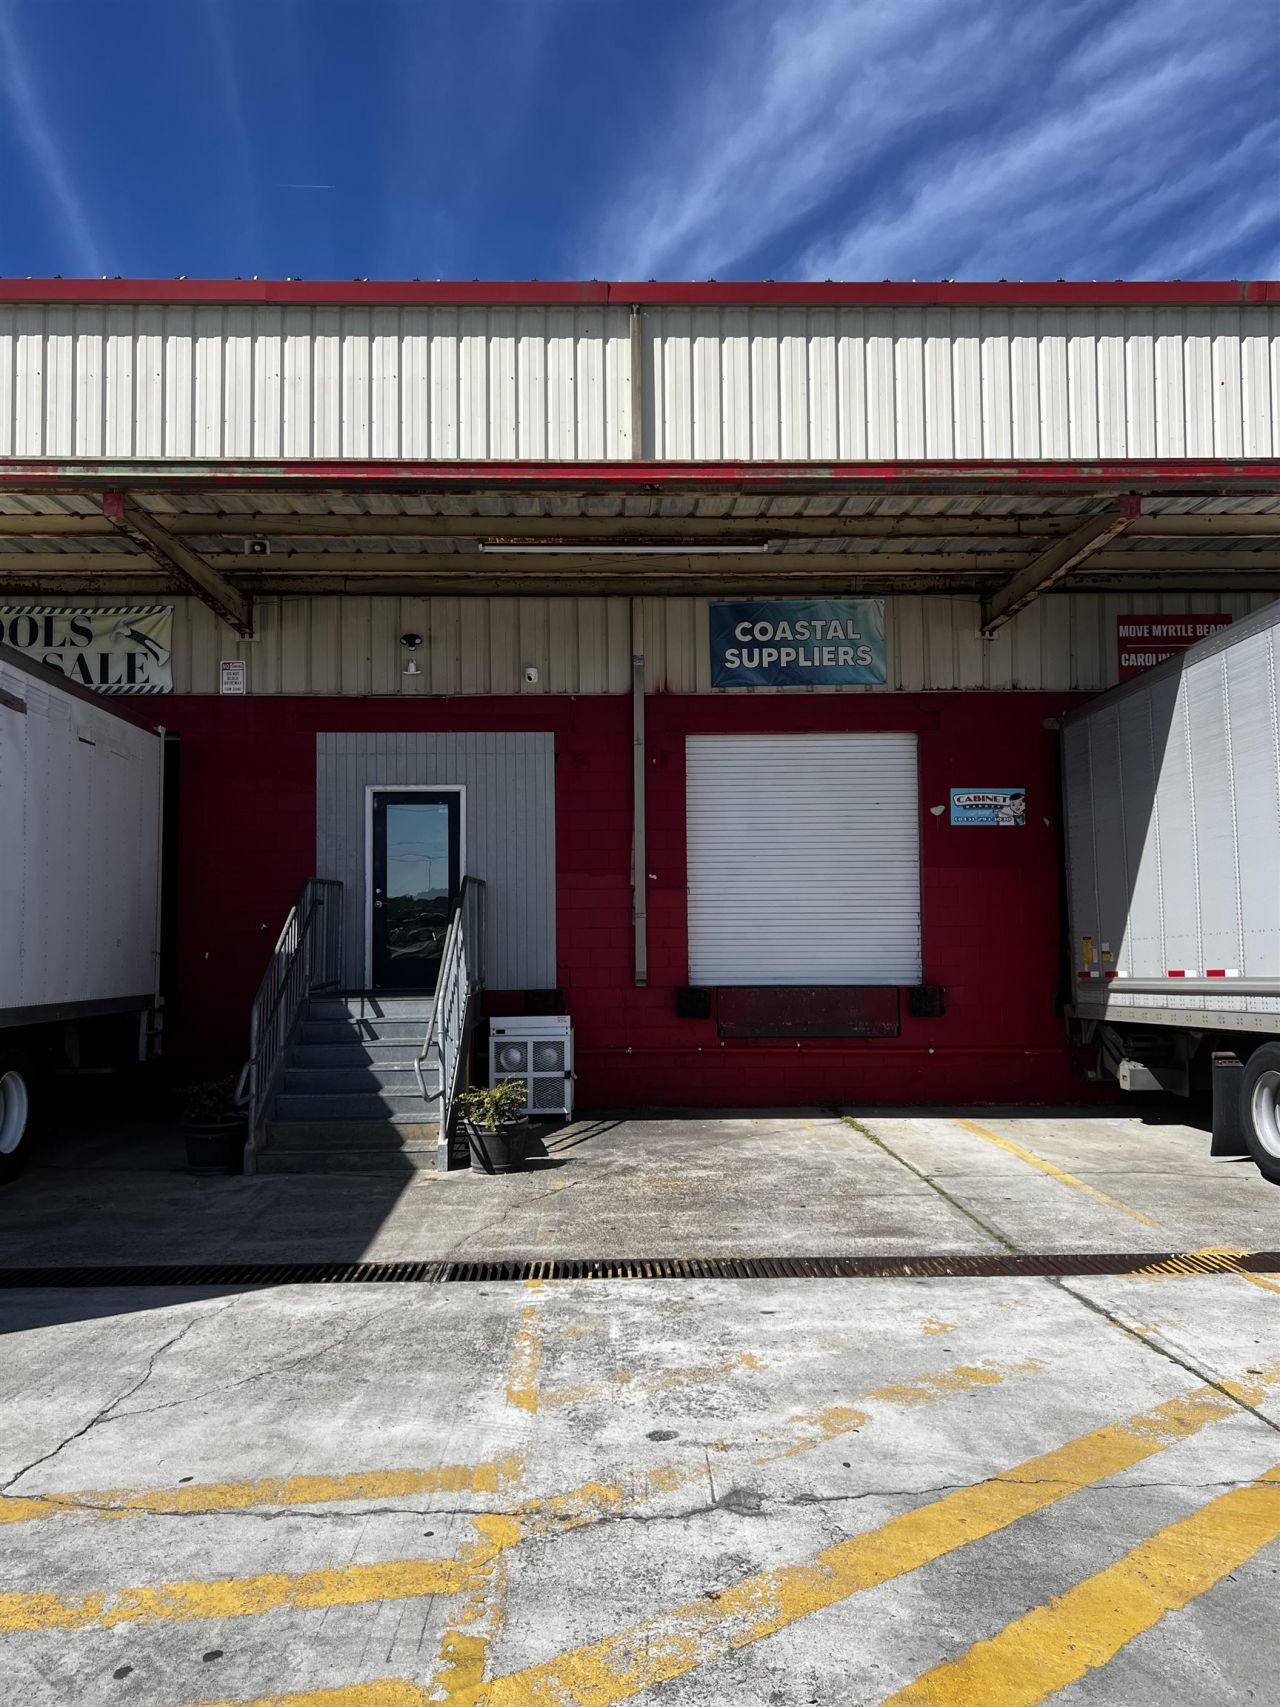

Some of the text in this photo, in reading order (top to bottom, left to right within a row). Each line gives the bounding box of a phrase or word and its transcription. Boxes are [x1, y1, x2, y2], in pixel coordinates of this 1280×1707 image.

[0, 615, 93, 648] OLS
[735, 619, 861, 642] COASTAL
[1119, 624, 1231, 637] MOVE MYRTLE BEAC
[724, 646, 873, 668] SUPPLIERS
[956, 795, 1009, 803] CABINET
